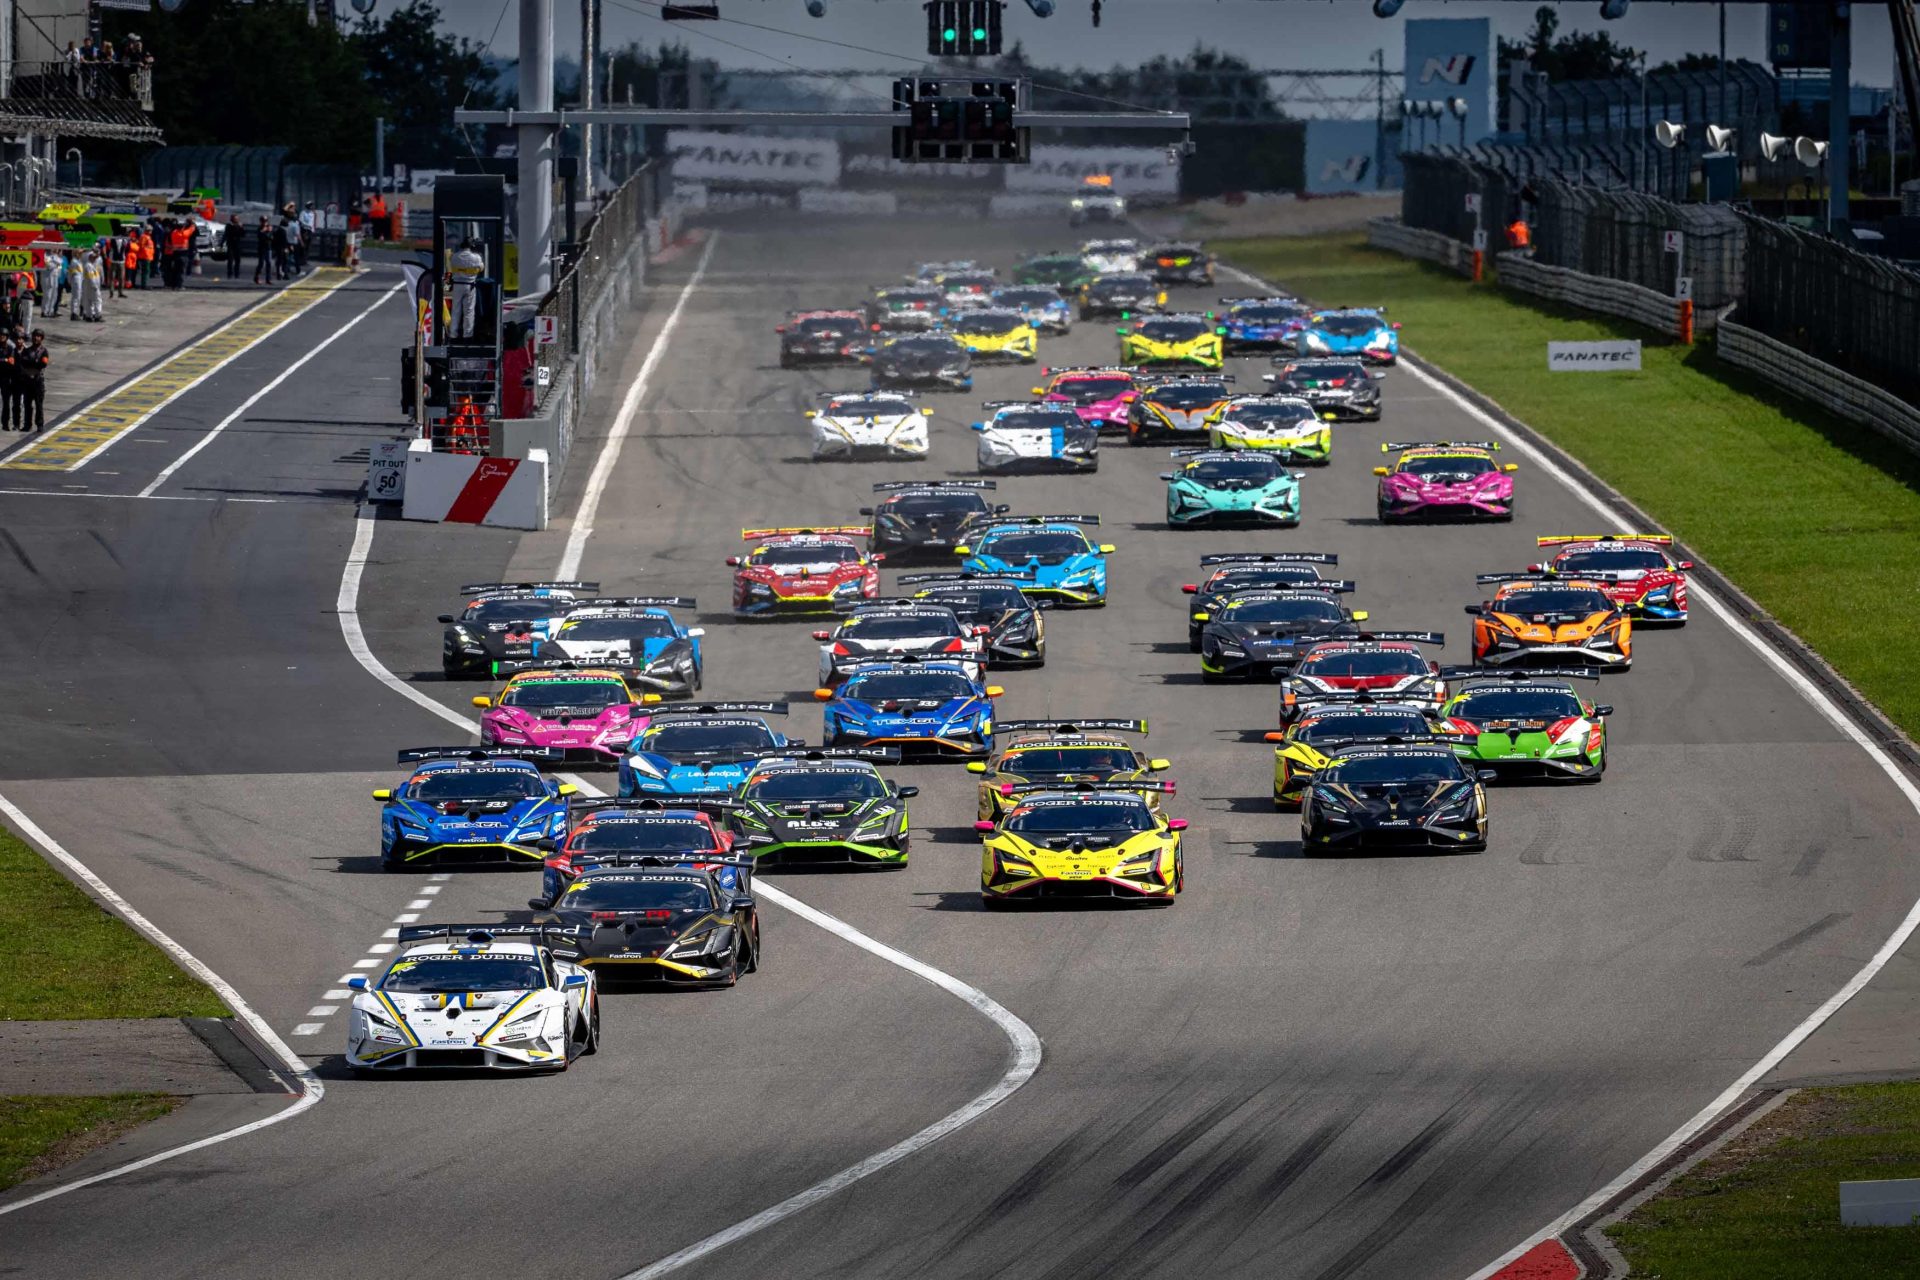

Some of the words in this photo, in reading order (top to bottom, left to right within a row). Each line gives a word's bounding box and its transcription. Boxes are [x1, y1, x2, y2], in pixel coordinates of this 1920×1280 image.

[1680, 281, 1687, 294] 2
[1554, 350, 1635, 361] FANATEC
[539, 368, 548, 379] 2a
[380, 476, 396, 488] 50
[1261, 580, 1344, 588] radstad
[1340, 632, 1431, 640] radstad
[680, 703, 773, 711] radstad
[1037, 721, 1134, 729] radstad
[452, 747, 550, 756] radstad
[786, 748, 887, 756] radstad
[688, 770, 741, 778] Lewandpol
[465, 925, 580, 935] randstad
[406, 955, 463, 963] ROGER
